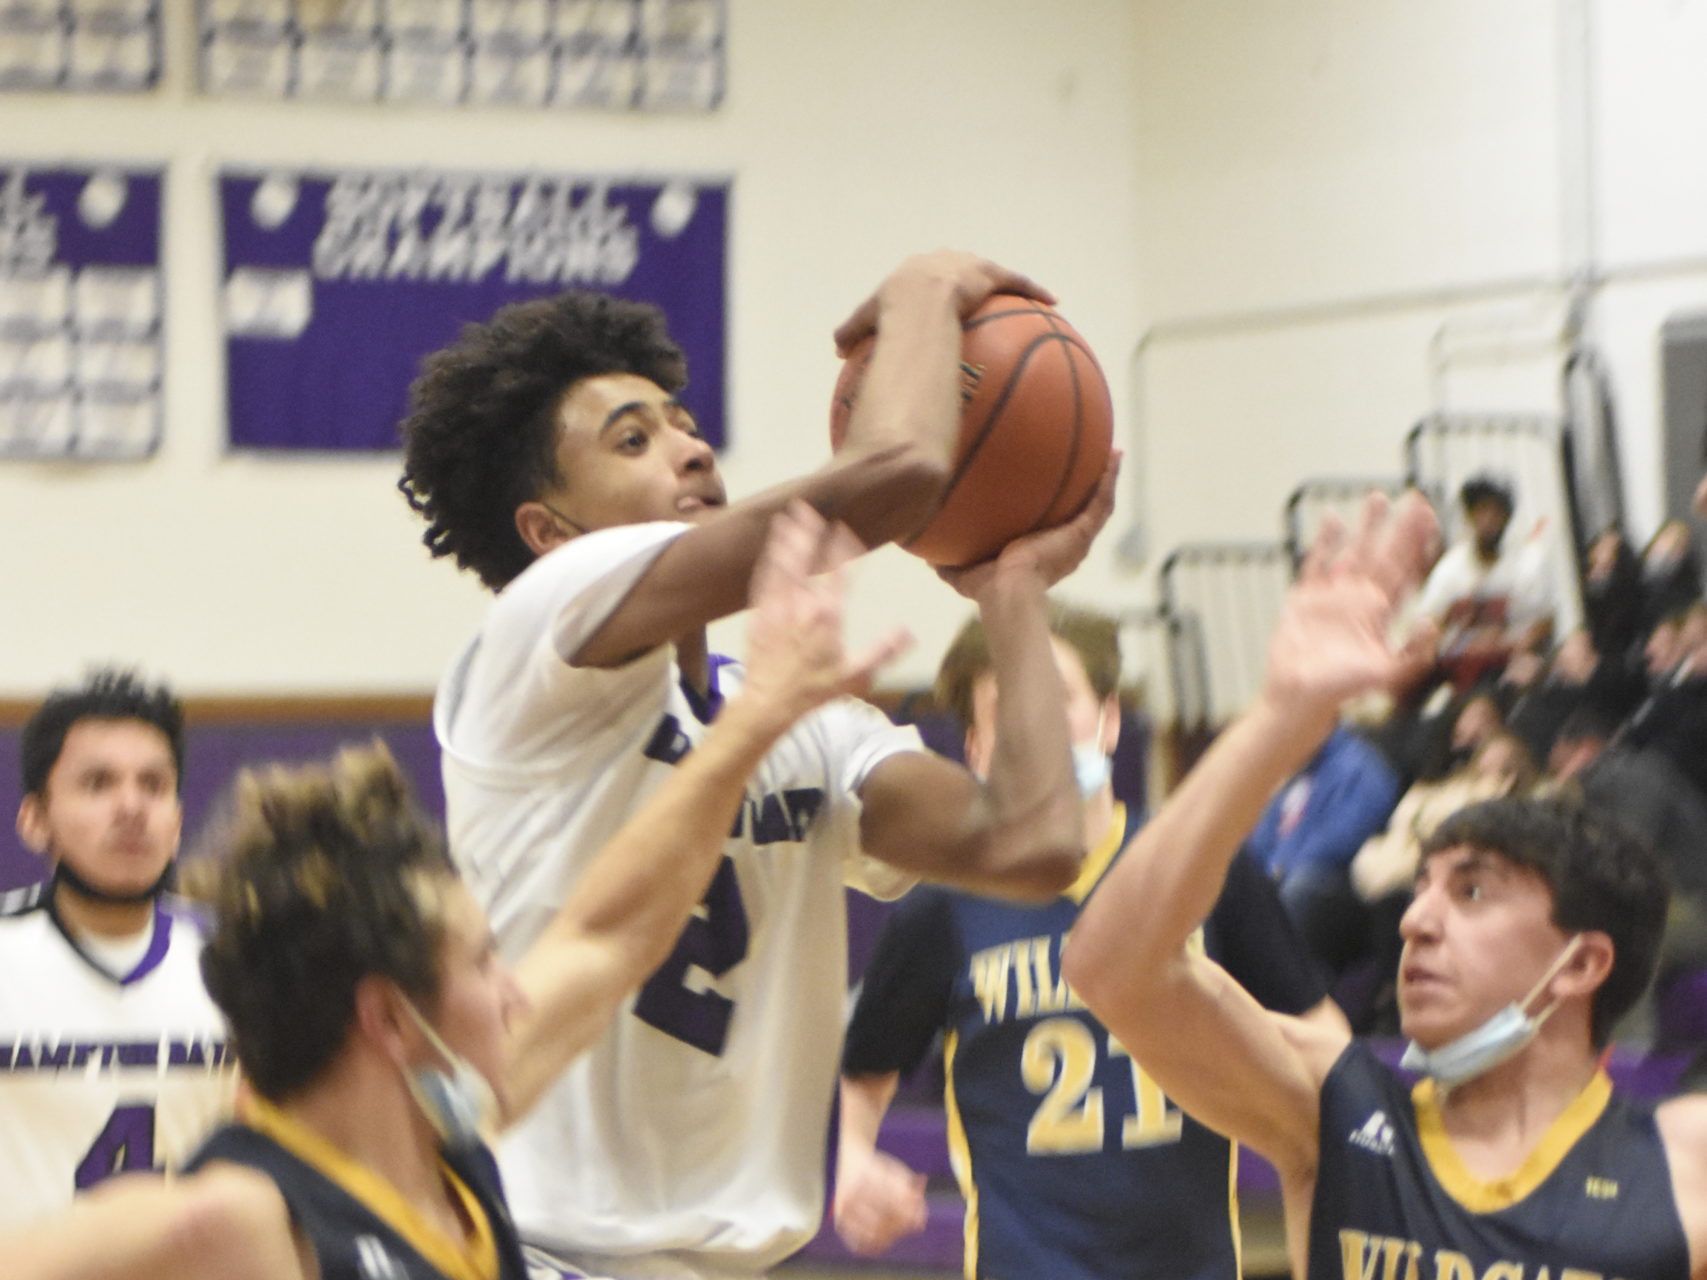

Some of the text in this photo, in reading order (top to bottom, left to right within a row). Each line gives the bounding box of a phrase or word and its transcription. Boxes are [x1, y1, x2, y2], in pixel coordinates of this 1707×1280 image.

[313, 220, 639, 281] CHAMPIONS
[632, 852, 750, 1058] 2
[1021, 1015, 1183, 1156] 21
[73, 1103, 168, 1190] 4
